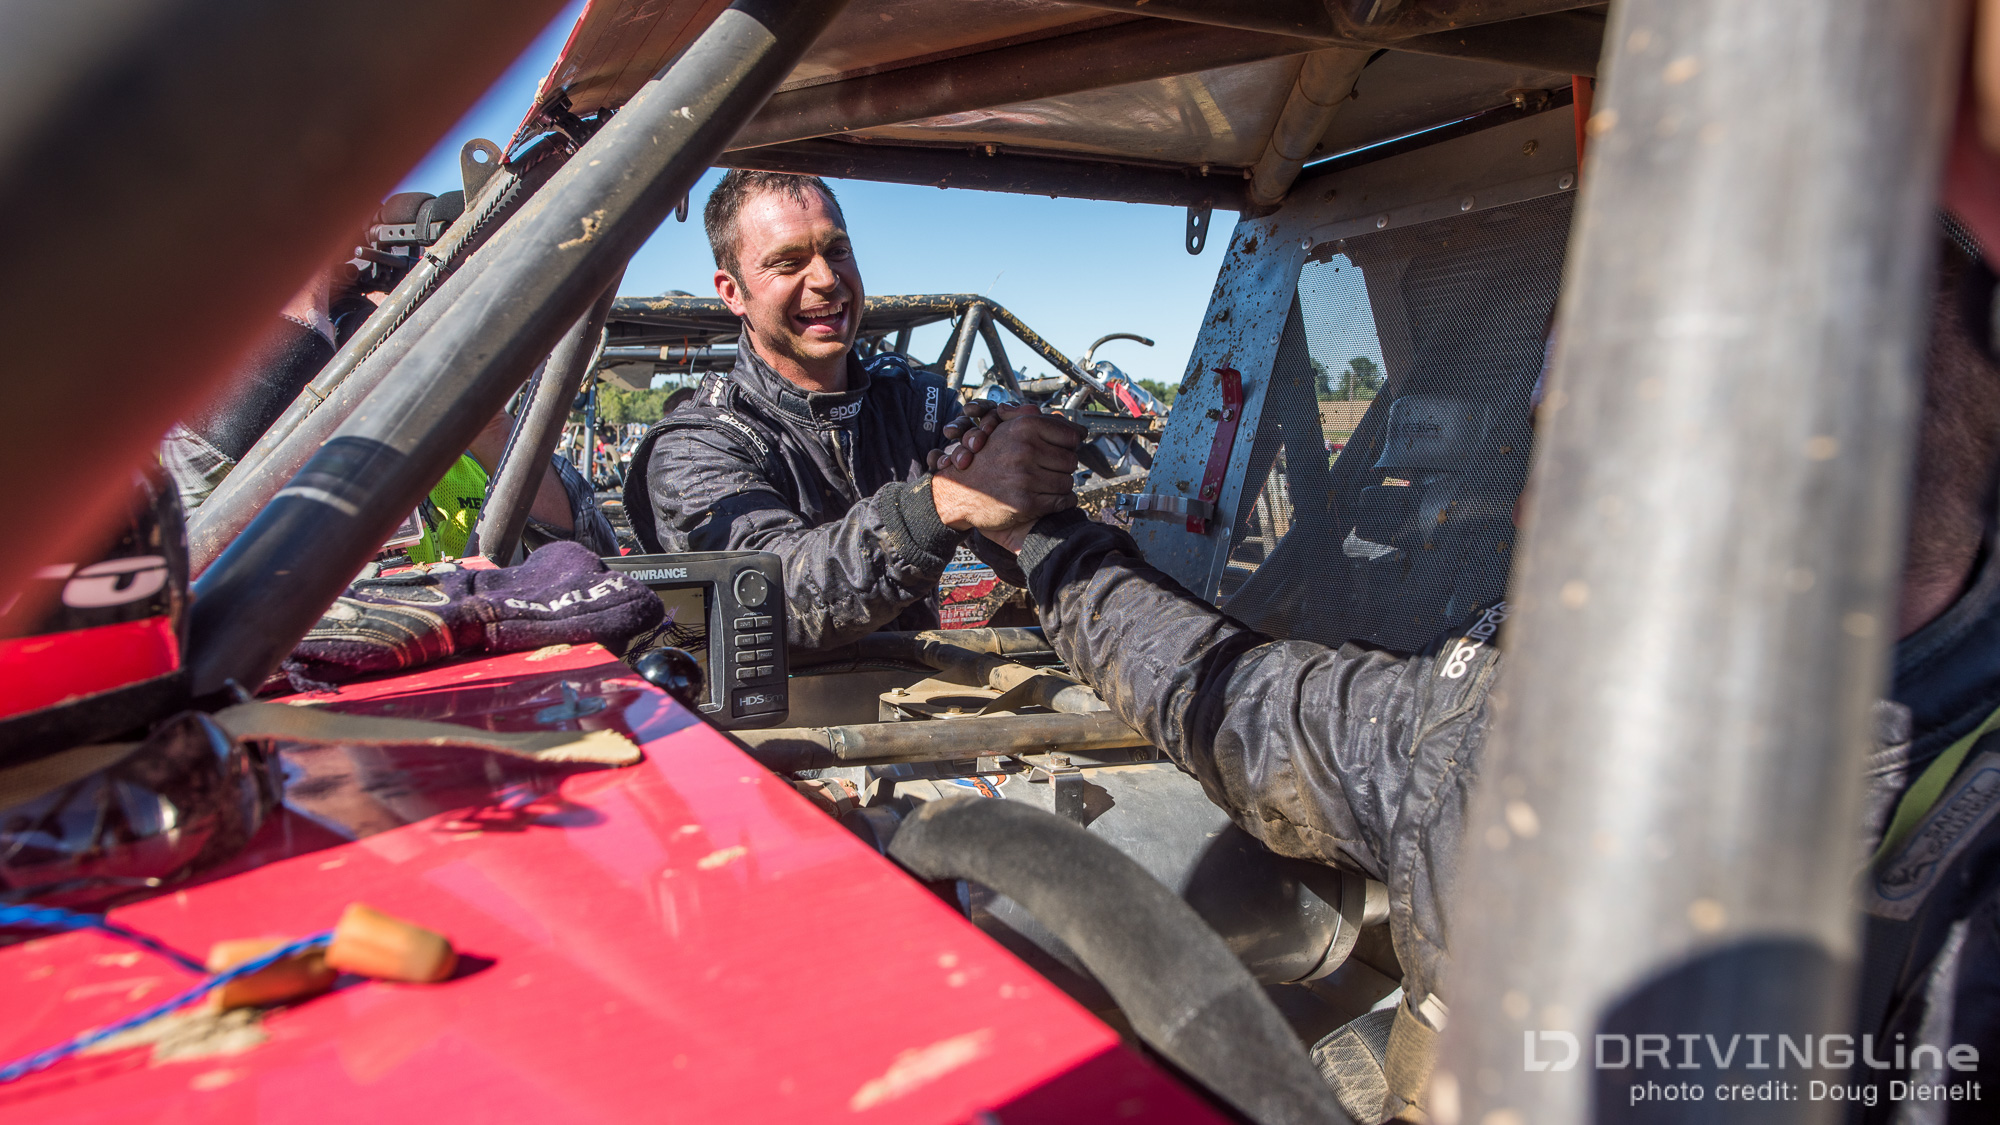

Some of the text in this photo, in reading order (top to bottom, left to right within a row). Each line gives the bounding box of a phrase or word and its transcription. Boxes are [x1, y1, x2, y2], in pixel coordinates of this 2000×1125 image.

[923, 386, 939, 433] sparco
[716, 414, 769, 456] sparco
[456, 496, 484, 509] ME
[504, 576, 628, 612] OAKLEY
[1440, 601, 1515, 679] sparco
[1924, 786, 1981, 839] SAFETY
